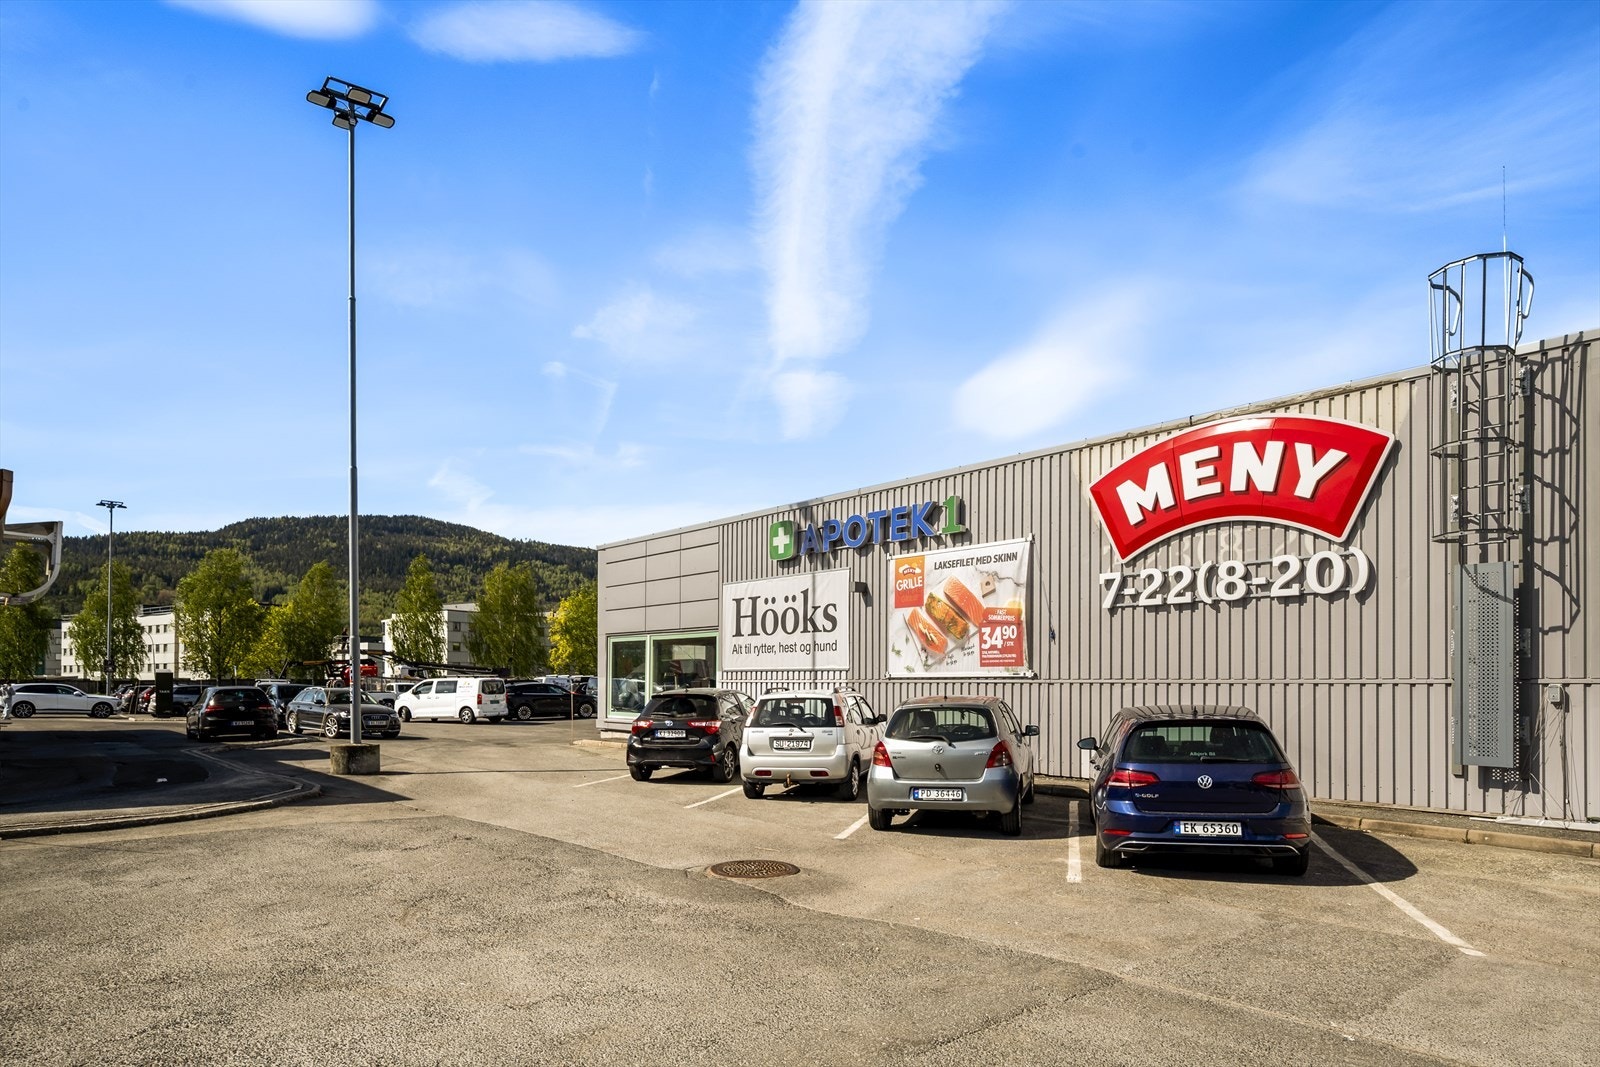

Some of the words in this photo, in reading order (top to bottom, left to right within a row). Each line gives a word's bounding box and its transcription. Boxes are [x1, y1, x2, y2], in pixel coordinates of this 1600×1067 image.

[1116, 440, 1348, 526] MENY
[800, 501, 937, 556] APOTEK
[942, 496, 966, 535] 1
[934, 557, 975, 571] LAKSEFILET
[976, 555, 992, 566] MED
[993, 552, 1018, 563] SKINN
[896, 576, 923, 591] GRILLE
[1099, 546, 1369, 608] 7-22(8-20)
[732, 588, 838, 637] Hööks
[732, 643, 743, 655] Alt
[744, 643, 752, 654] til
[753, 643, 777, 656] rytter,
[778, 641, 798, 654] hest
[799, 643, 811, 655] og
[813, 639, 838, 652] hund
[775, 740, 784, 748] SU
[920, 789, 932, 798] PD
[935, 789, 961, 798] 36446
[1183, 822, 1197, 833] EK
[1202, 822, 1239, 834] 65360
